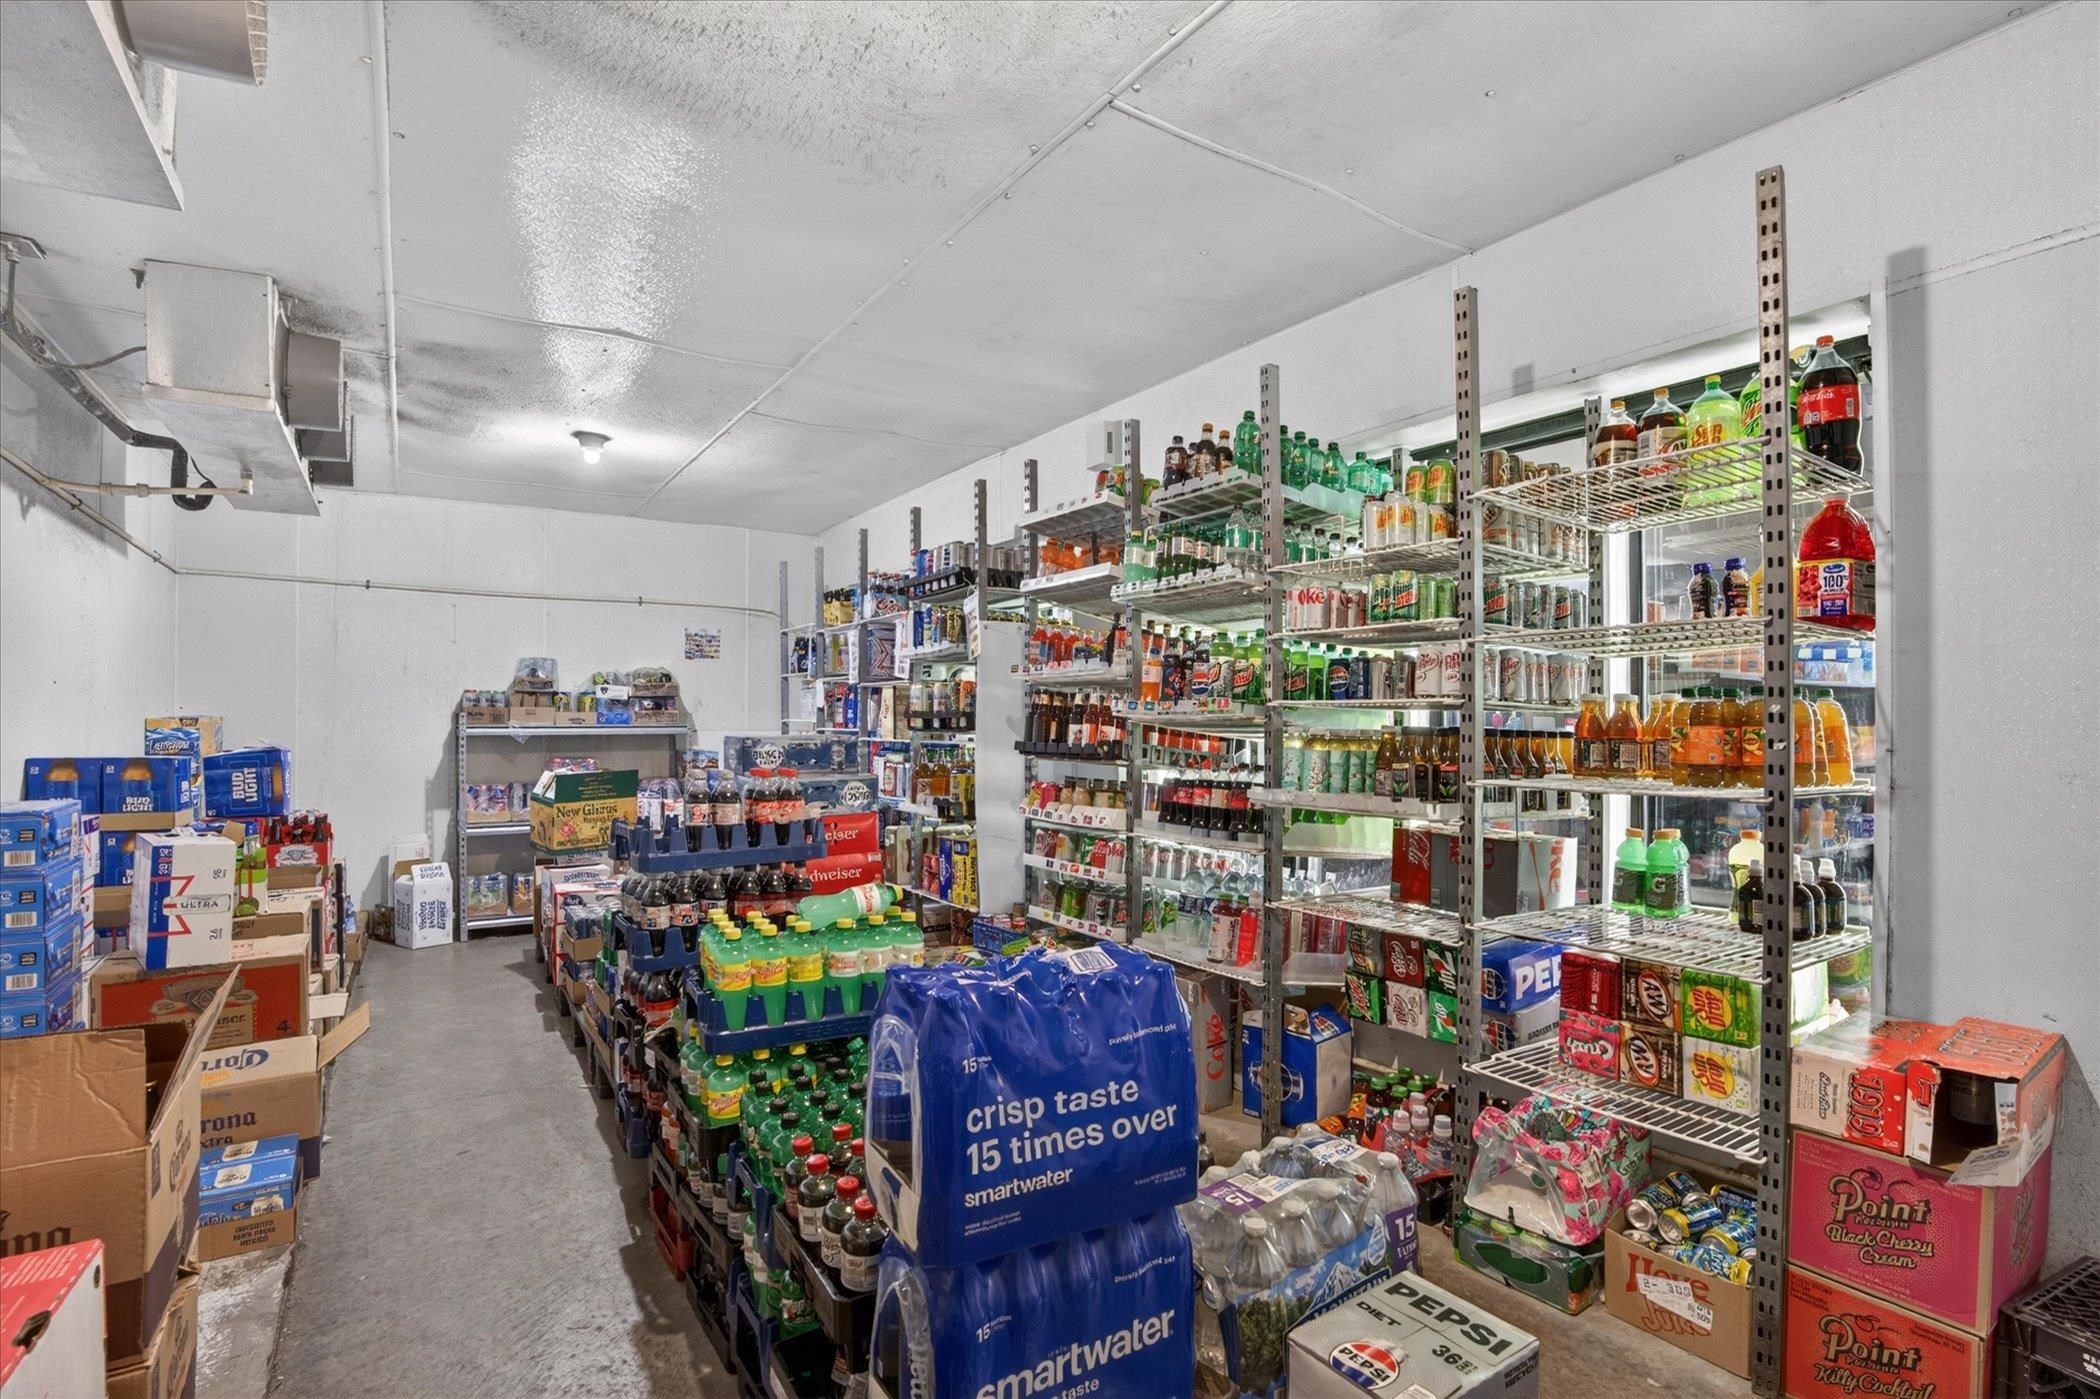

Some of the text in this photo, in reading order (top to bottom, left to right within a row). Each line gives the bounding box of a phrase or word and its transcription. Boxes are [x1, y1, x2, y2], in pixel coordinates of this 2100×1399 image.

[232, 772, 245, 799] BUD
[245, 767, 258, 803] LIGHT
[556, 805, 581, 819] New
[962, 1056, 978, 1075] 15
[966, 1079, 1140, 1134] crisp taste
[966, 1104, 1178, 1176] 15 times over
[964, 1167, 1074, 1208] smartwater
[1827, 1174, 1931, 1225] Point
[1394, 1213, 1416, 1241] 15
[1825, 1222, 1876, 1247] Black
[1876, 1228, 1935, 1257] Cherry
[1858, 1246, 1917, 1269] Cream
[1355, 1301, 1402, 1327] DIET
[1384, 1281, 1513, 1356] PEPSI
[976, 1321, 991, 1344] 15
[1818, 1313, 1923, 1372] Point
[975, 1308, 1176, 1399] smartwater
[1338, 1347, 1392, 1383] PEPSI
[1431, 1344, 1463, 1367] 36
[1857, 1372, 1938, 1399] Cocktail
